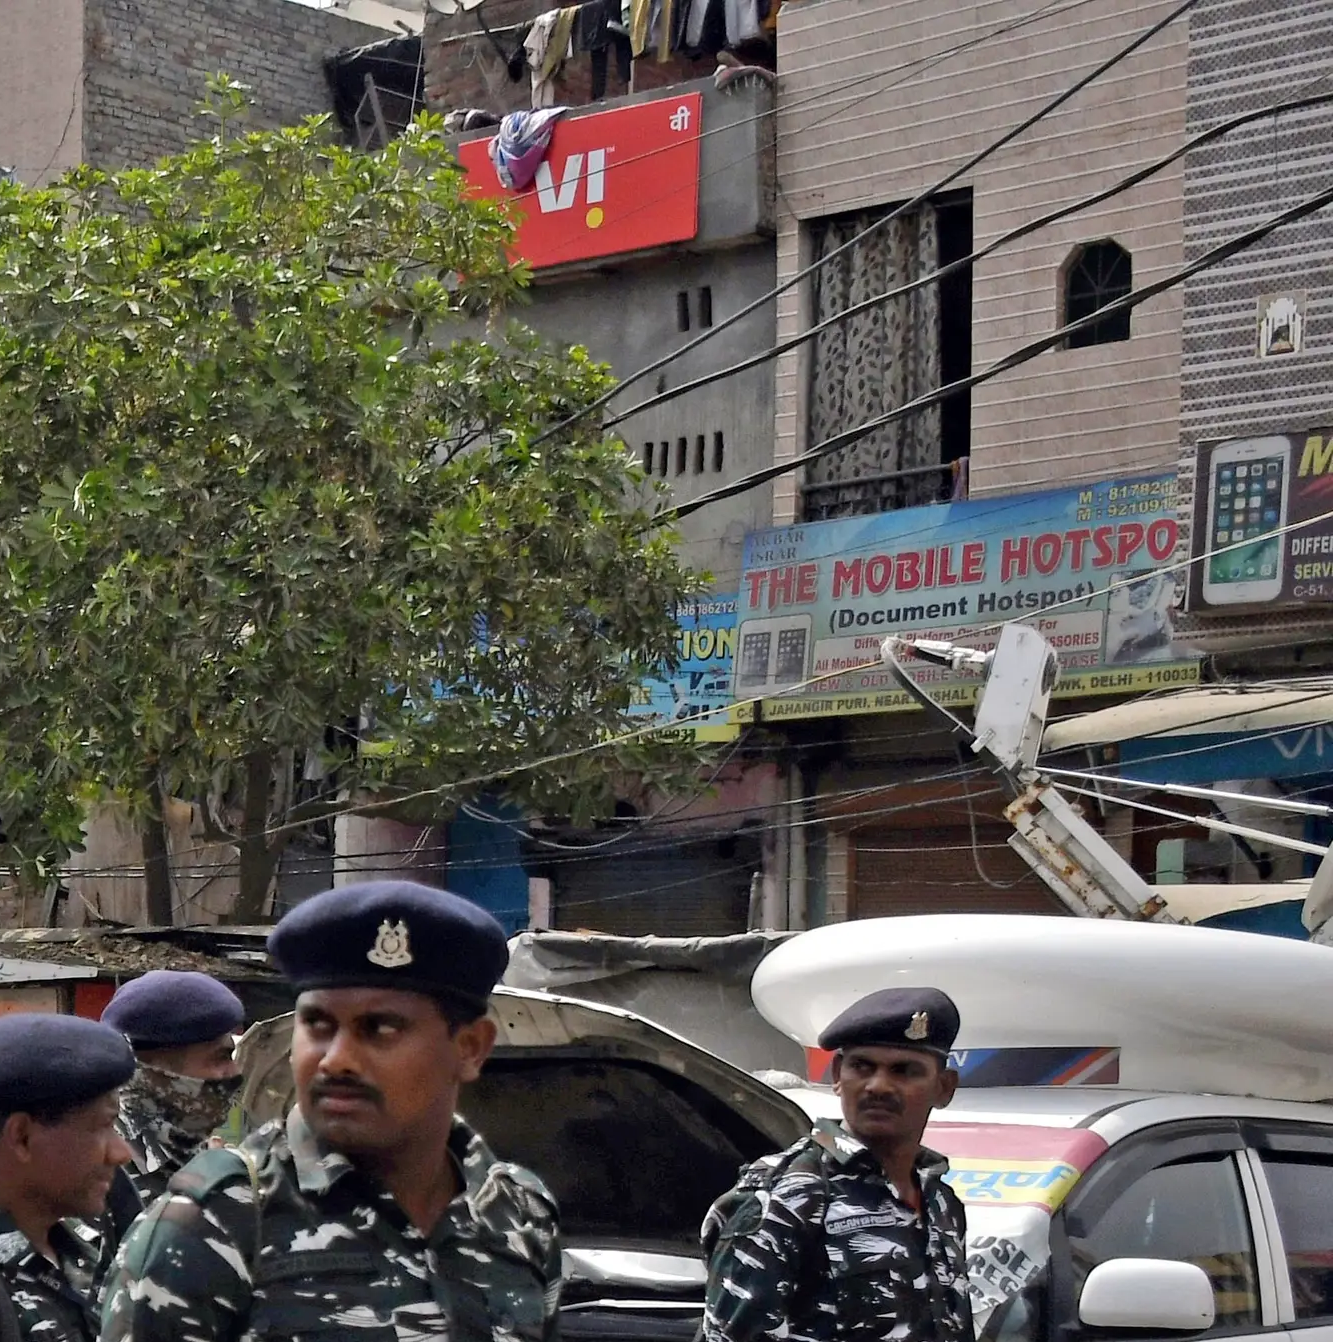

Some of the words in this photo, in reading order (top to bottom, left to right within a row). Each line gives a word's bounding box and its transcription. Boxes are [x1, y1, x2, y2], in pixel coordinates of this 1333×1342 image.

[669, 105, 691, 131] वी
[744, 563, 819, 612] THE
[831, 541, 986, 600] MOBILE
[830, 597, 968, 633] (Document
[977, 580, 1095, 613] Hotspot)
[769, 699, 833, 717] JAHANGIR
[875, 694, 910, 707] NEAR
[1091, 672, 1133, 688] DELHI
[1147, 668, 1197, 684] 110033
